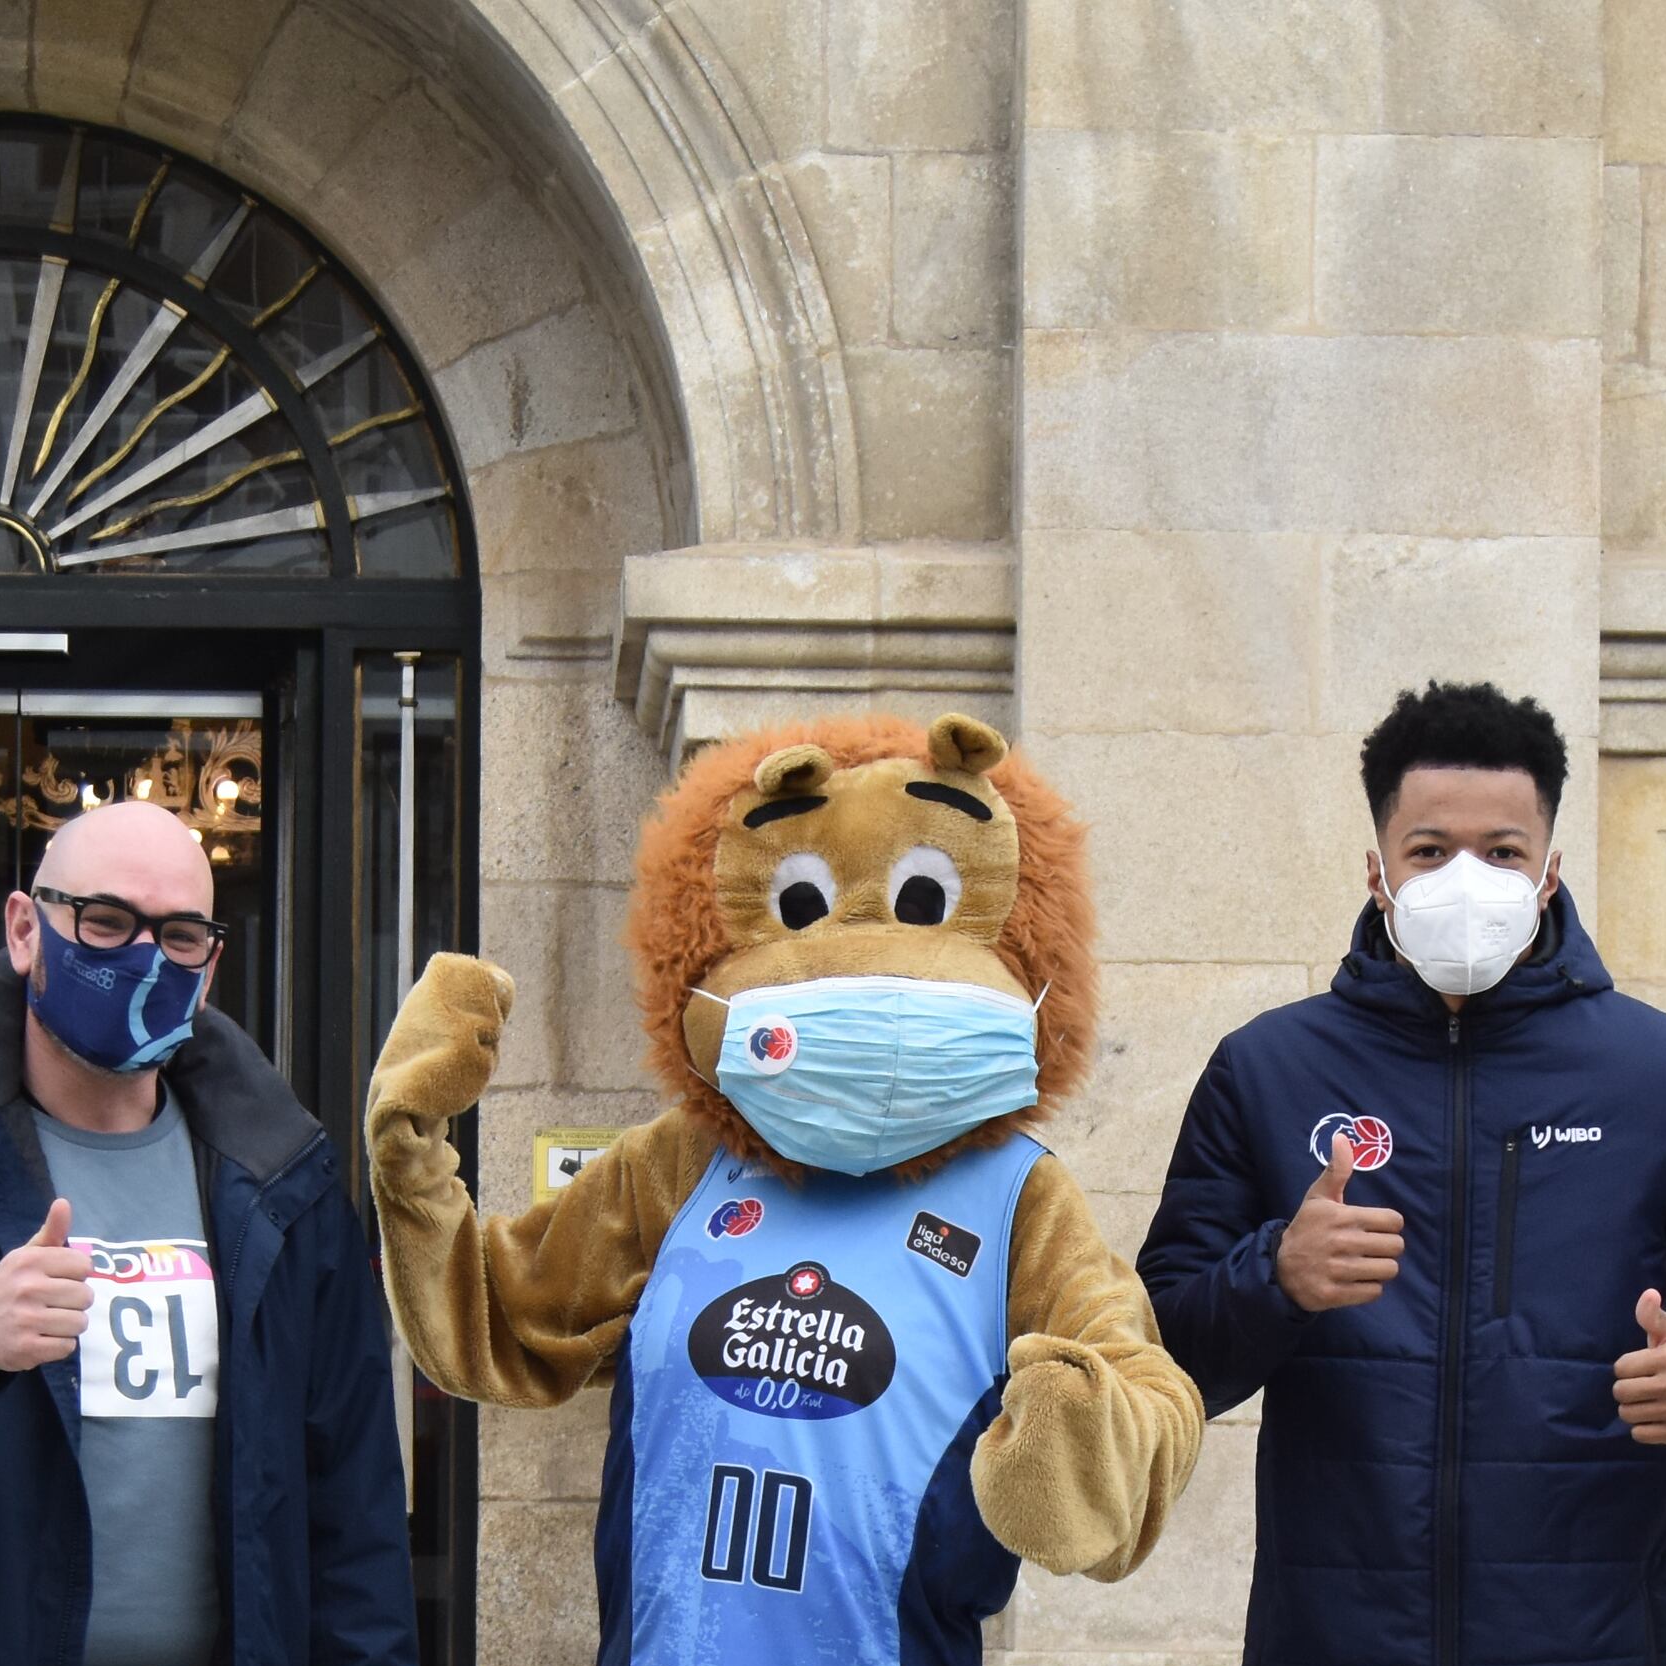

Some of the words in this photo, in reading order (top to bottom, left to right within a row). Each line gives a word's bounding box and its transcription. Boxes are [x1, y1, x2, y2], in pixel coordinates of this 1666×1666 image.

[1554, 1126, 1602, 1143] WIBO
[913, 1238, 968, 1272] endesa
[917, 1224, 944, 1245] liga
[724, 1297, 866, 1353] Estrella
[109, 1293, 203, 1401] 13
[722, 1335, 849, 1388] Galicia
[754, 1376, 800, 1410] 0,0
[700, 1462, 814, 1596] 00
